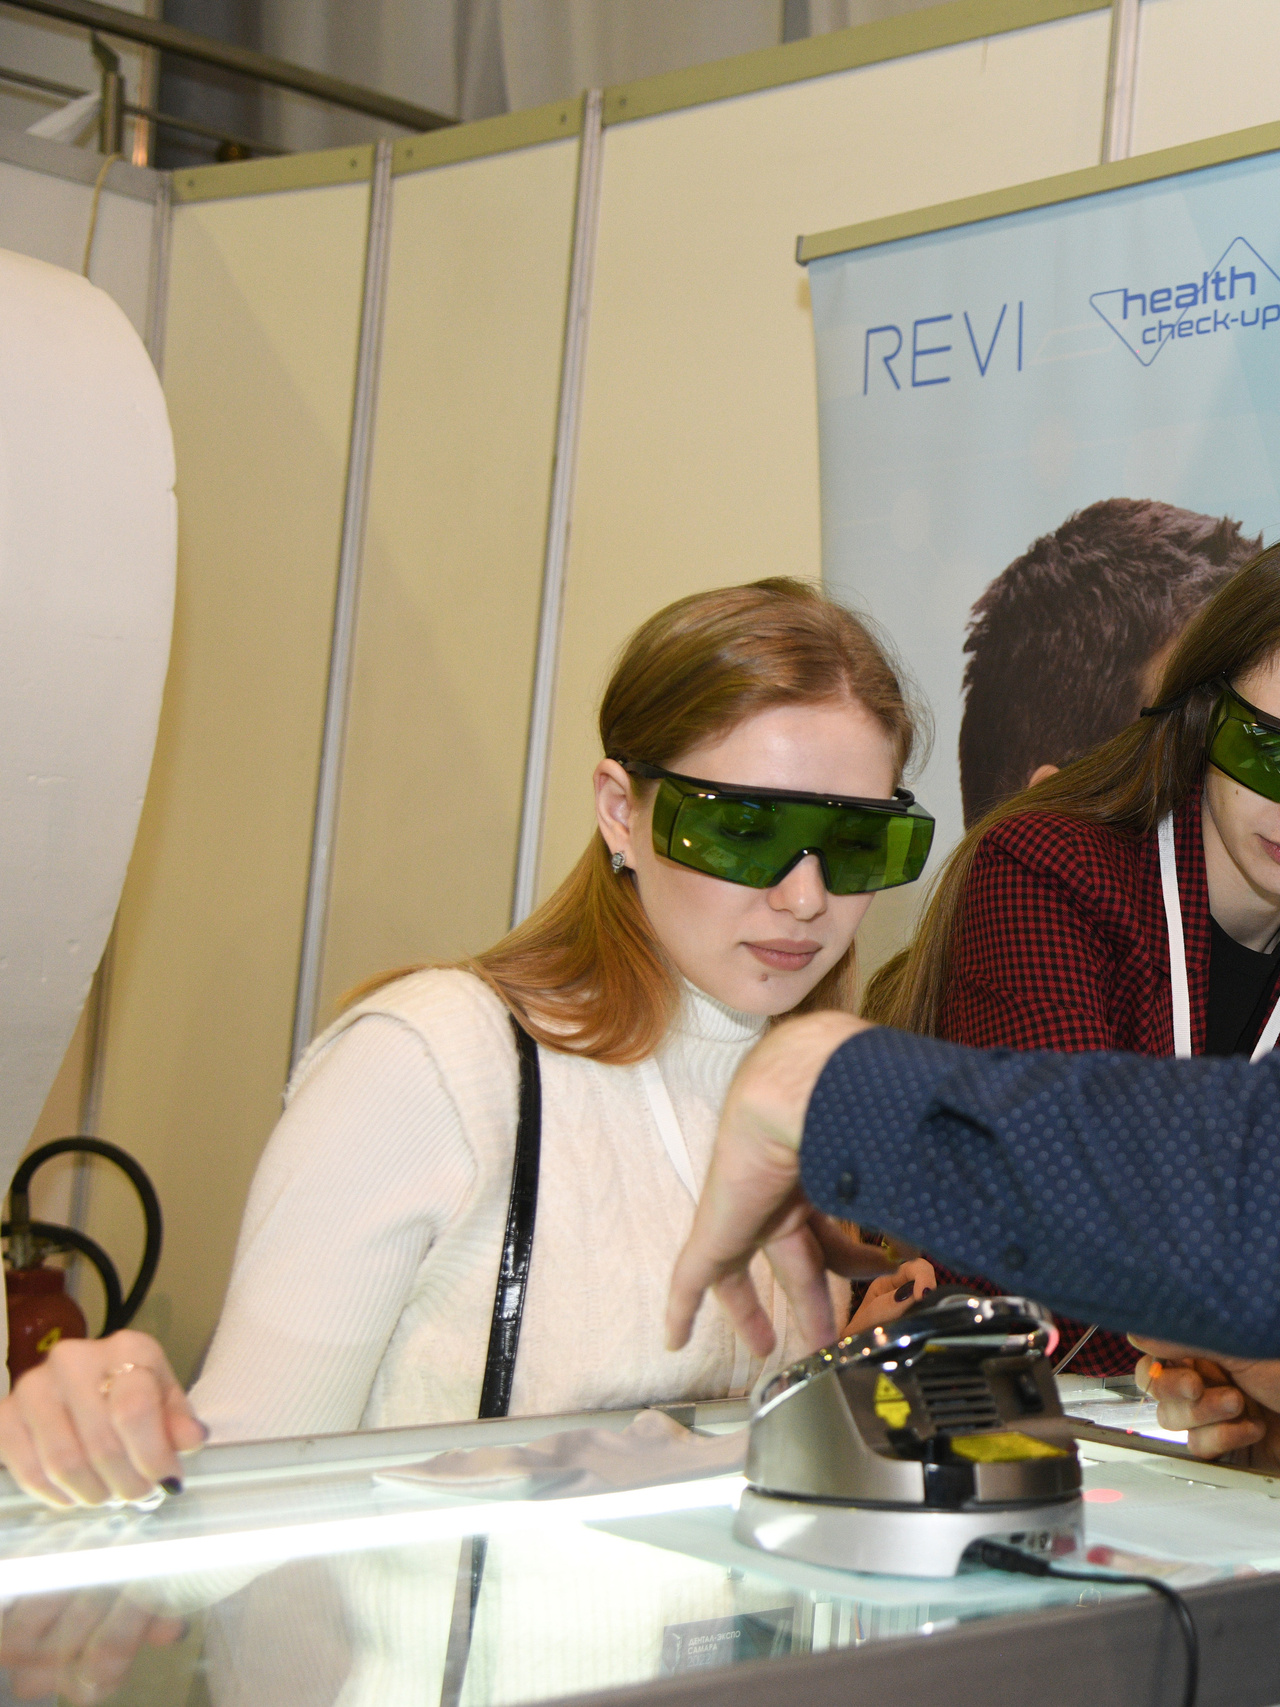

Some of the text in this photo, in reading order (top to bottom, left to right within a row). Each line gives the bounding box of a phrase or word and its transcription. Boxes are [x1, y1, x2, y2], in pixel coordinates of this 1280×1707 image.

[1121, 265, 1257, 320] health
[863, 301, 1024, 396] REVI
[687, 1643, 718, 1655] САМАРА
[688, 1630, 741, 1647] ДЕНТАЛ-ЭКСПО
